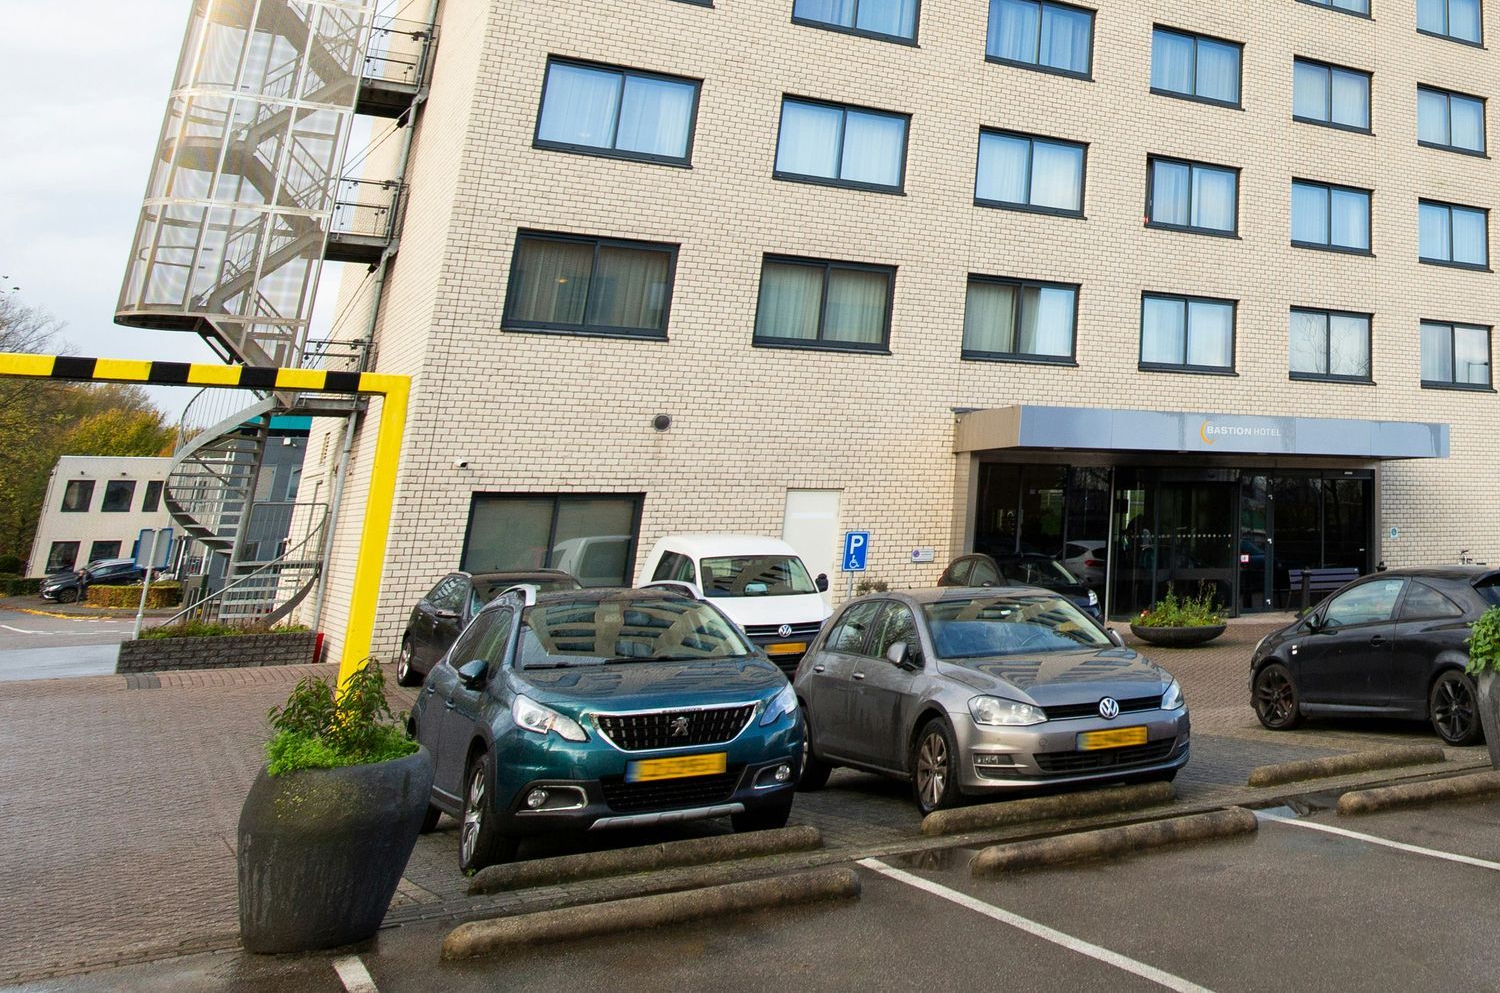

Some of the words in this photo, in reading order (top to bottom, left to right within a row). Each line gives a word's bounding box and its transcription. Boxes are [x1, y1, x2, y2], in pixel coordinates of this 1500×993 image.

[1207, 426, 1251, 436] BASTION
[1253, 428, 1281, 437] HOTEL
[850, 535, 864, 554] P
[1099, 697, 1119, 718] VW
